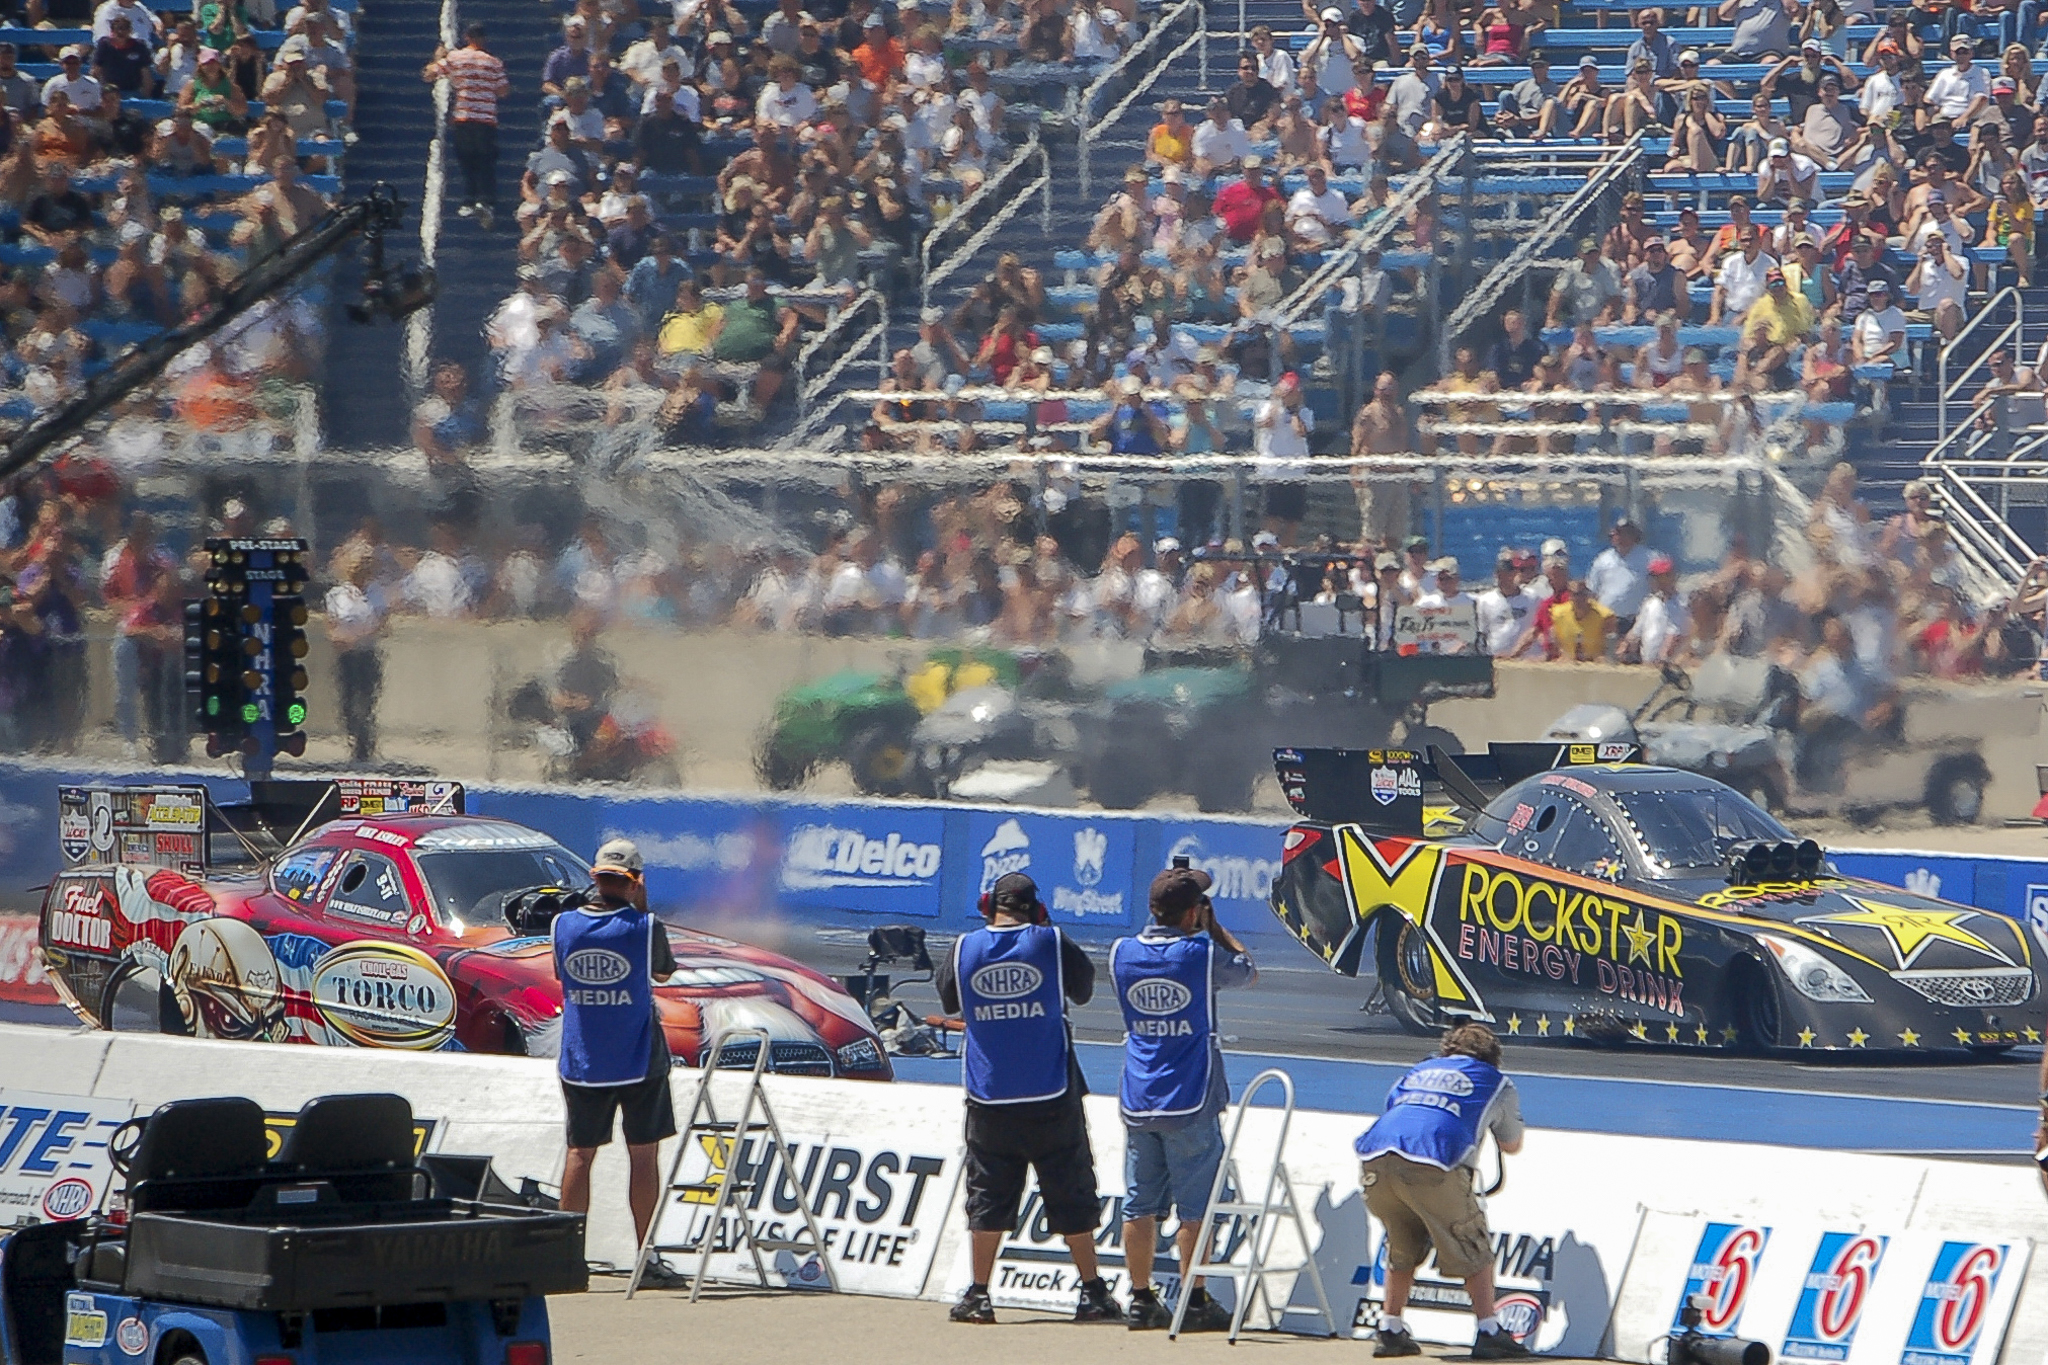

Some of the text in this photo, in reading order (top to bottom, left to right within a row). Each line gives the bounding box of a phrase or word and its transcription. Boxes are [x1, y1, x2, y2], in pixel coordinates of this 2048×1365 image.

[229, 540, 300, 550] PRE-STAGE
[246, 570, 285, 580] STAGE
[252, 622, 271, 721] NHRA
[1399, 787, 1421, 796] TOOLS
[156, 833, 194, 854] SKULL
[65, 885, 103, 914] Fuel
[52, 911, 111, 949] DOCTOR
[573, 955, 621, 979] NHRA
[1459, 923, 1684, 1018] ENERGY DRINK
[981, 969, 1033, 993] NHRA
[332, 977, 436, 1014] TORCO
[569, 990, 633, 1006] MEDIA
[1135, 989, 1180, 1011] NHRA
[974, 1002, 1046, 1021] MEDIA
[1131, 1019, 1194, 1038] MEDIA
[1393, 1092, 1461, 1118] MEDIA
[726, 1137, 946, 1227] HURST
[49, 1183, 90, 1215] NHRA
[1000, 1265, 1068, 1292] Truck
[1070, 1268, 1123, 1293] Ad
[1706, 1229, 1760, 1326] 6
[1806, 1238, 1878, 1337] MOTEL 6
[1924, 1247, 1997, 1346] MOTEL 6
